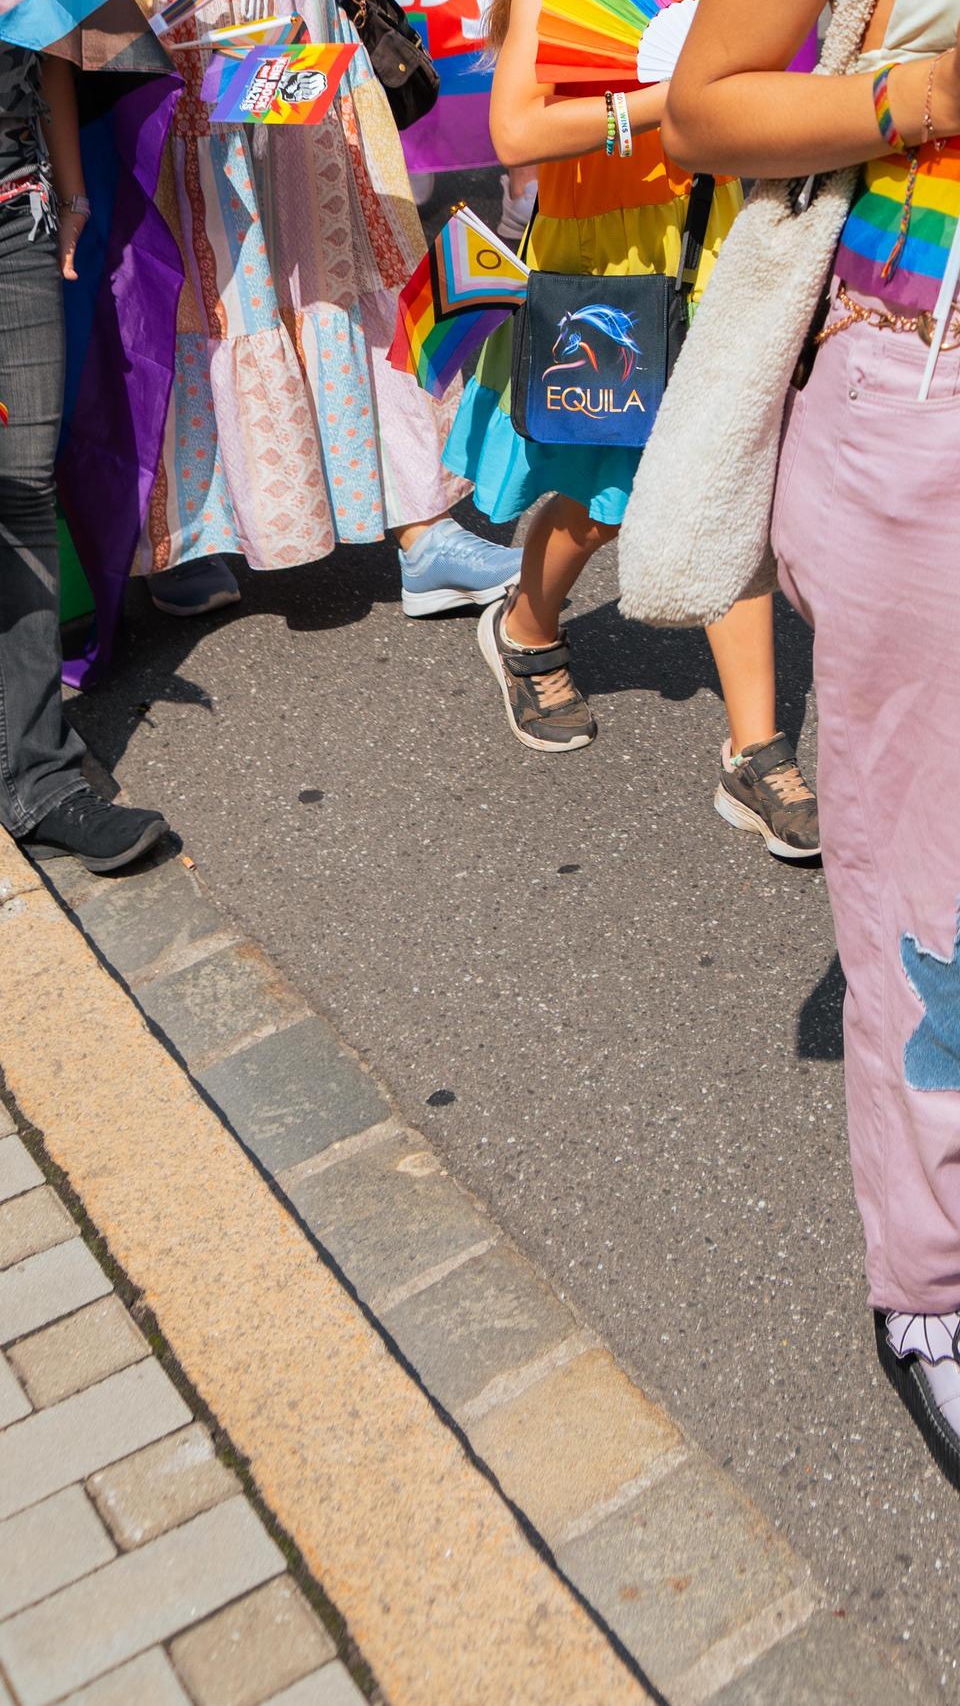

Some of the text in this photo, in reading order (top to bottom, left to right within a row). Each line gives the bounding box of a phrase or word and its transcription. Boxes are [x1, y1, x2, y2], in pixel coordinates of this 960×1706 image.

[240, 78, 266, 111] NAZIS
[256, 82, 277, 110] BOCK
[620, 112, 629, 134] WINS
[546, 386, 646, 419] EQUILA
